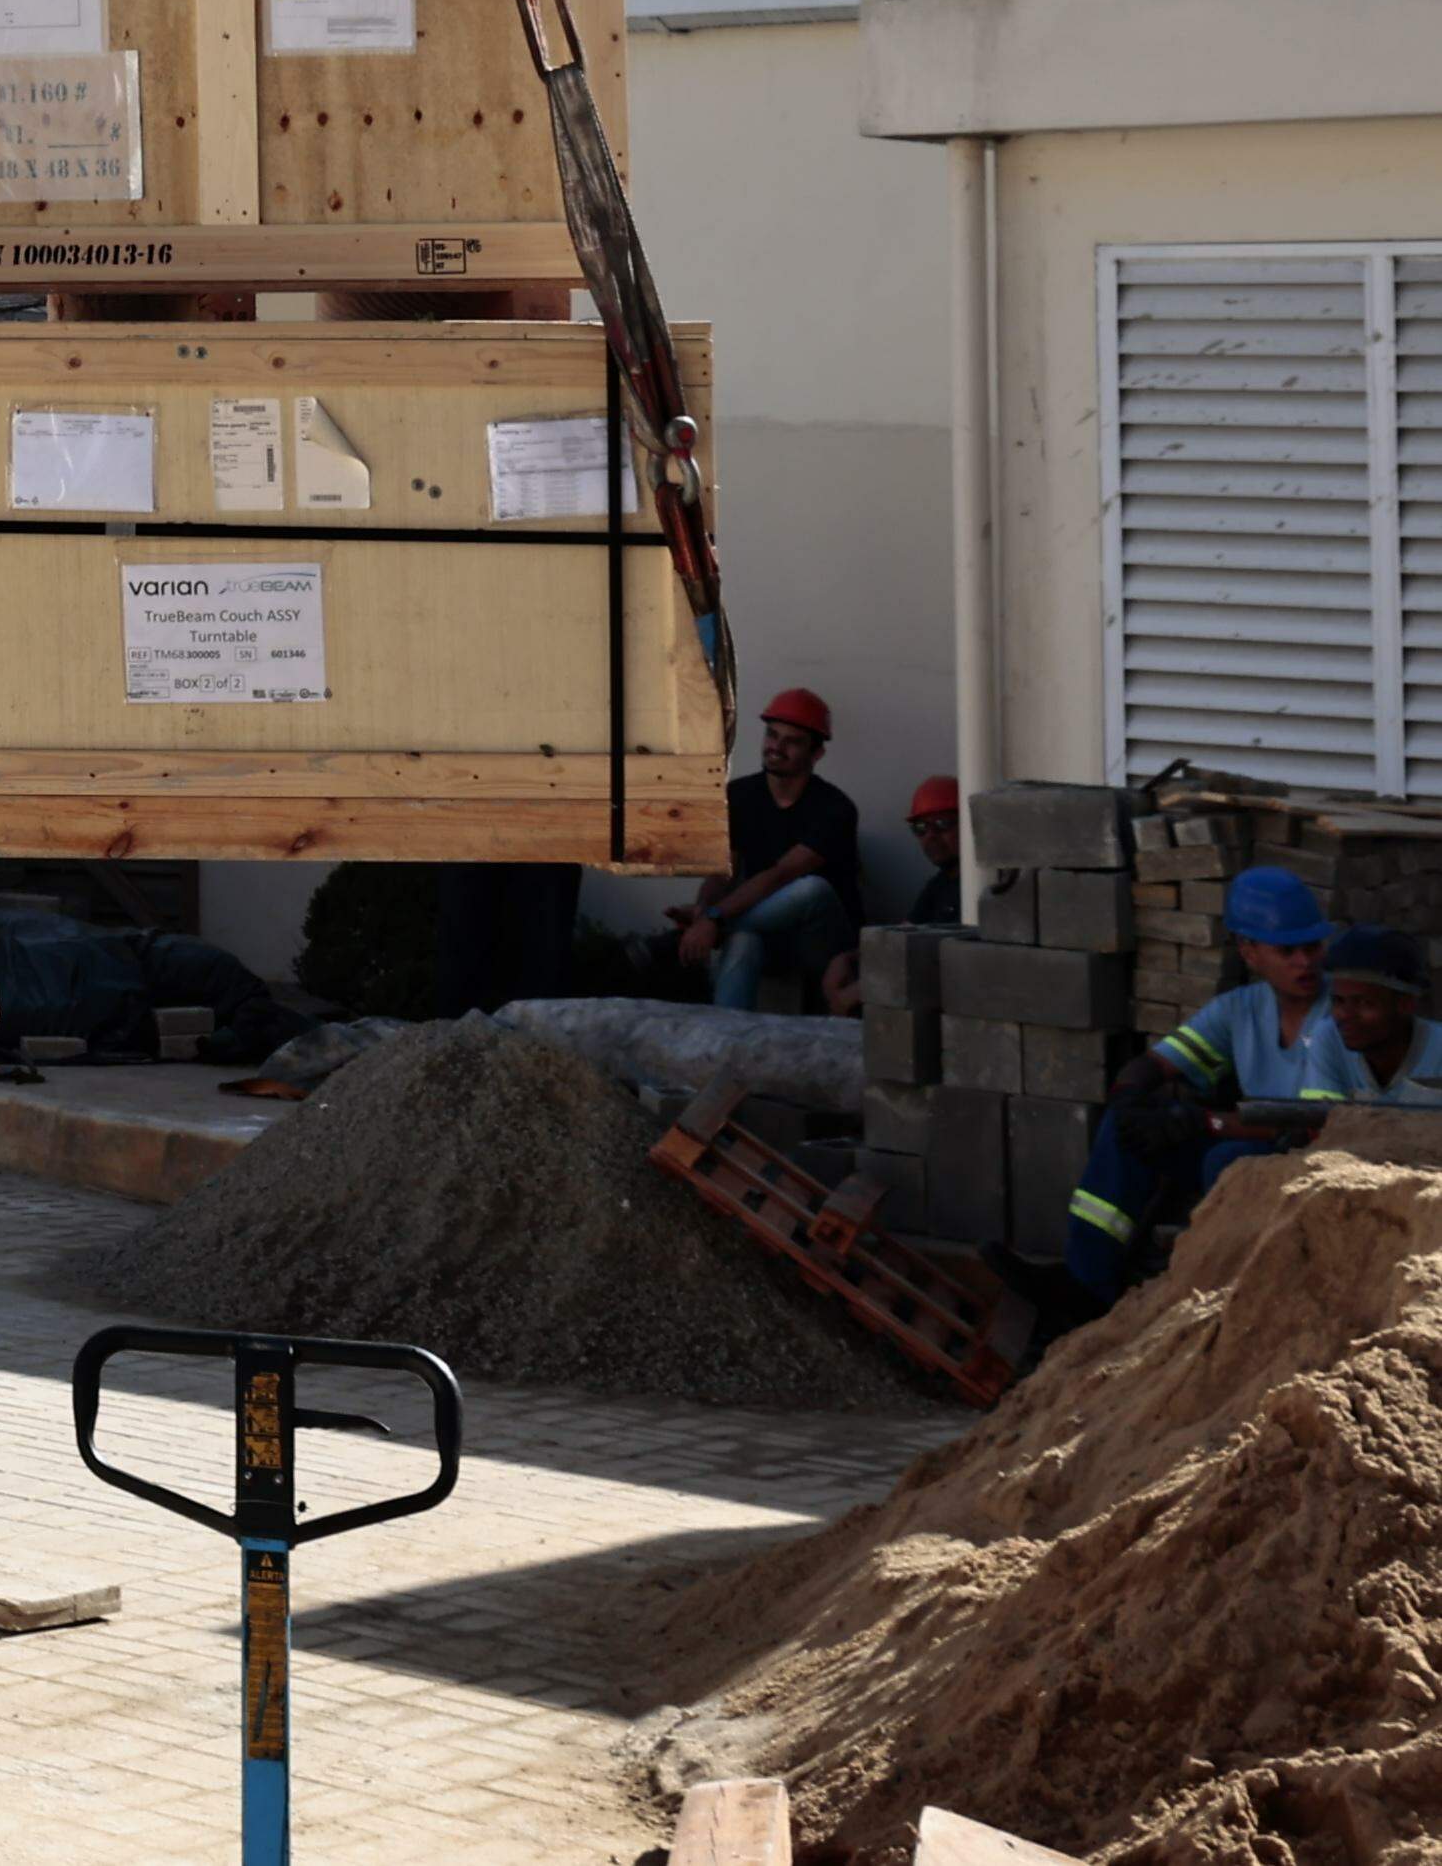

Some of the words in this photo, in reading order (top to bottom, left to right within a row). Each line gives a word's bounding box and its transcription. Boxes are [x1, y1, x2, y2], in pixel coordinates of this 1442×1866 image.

[95, 157, 122, 178] 36
[12, 243, 173, 266] 100034013-16
[128, 579, 210, 596] varian
[144, 610, 216, 623] TrueBeam
[219, 609, 263, 623] Couch
[266, 608, 301, 622] ASSY
[189, 628, 258, 643] Turntable
[130, 650, 149, 660] REF
[238, 649, 253, 660] SN
[270, 649, 307, 659] 601346
[174, 678, 200, 689] BOX
[203, 678, 211, 689] 2
[215, 676, 228, 689] of
[234, 678, 242, 689] 2
